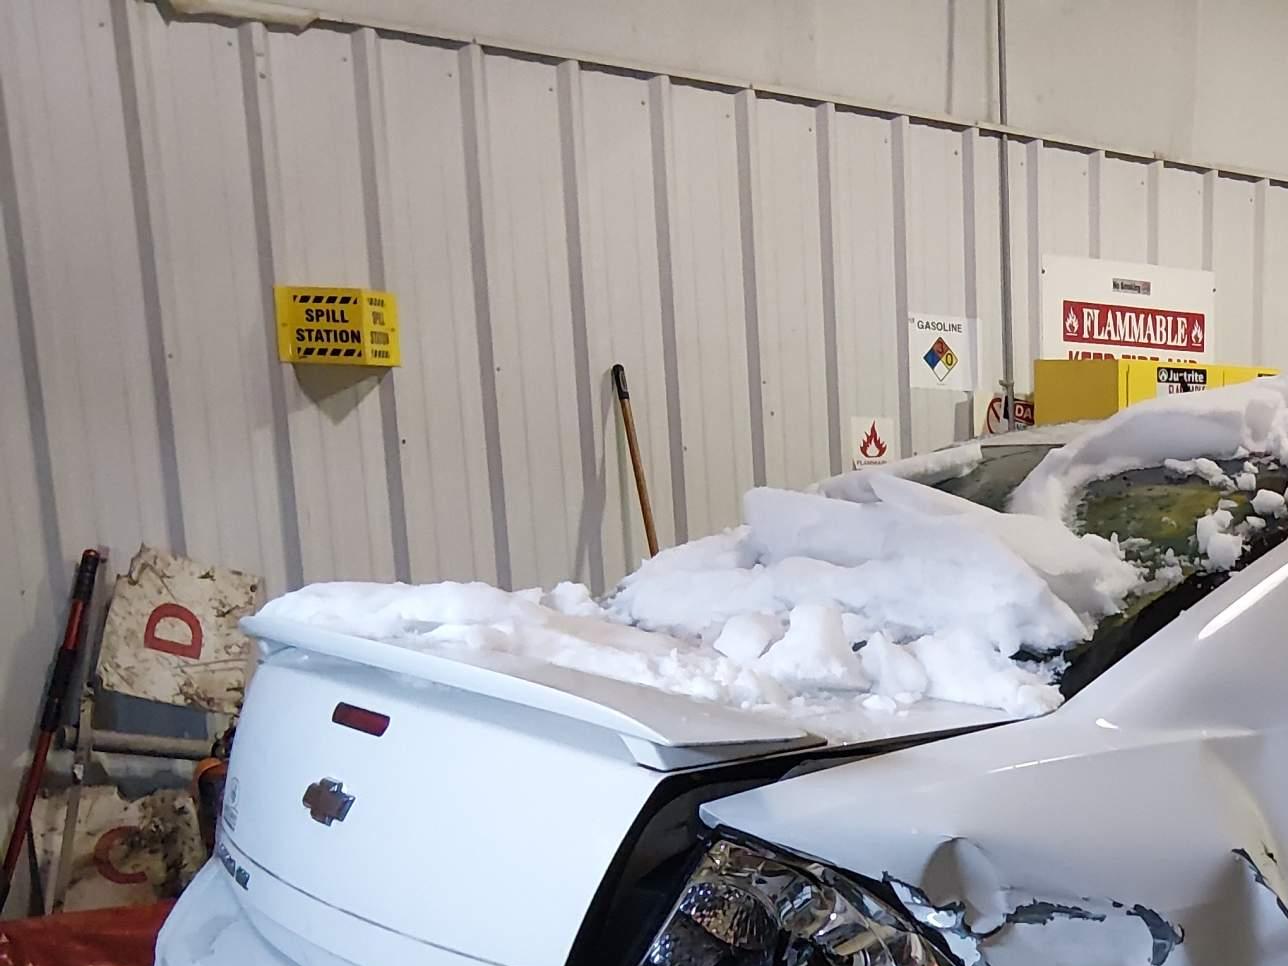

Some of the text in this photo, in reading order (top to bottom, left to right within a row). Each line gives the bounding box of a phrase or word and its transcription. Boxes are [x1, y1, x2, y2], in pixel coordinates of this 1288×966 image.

[305, 308, 349, 323] SPILL
[917, 320, 963, 333] GASOLINE
[1082, 308, 1188, 347] FLAMMABLE
[296, 328, 362, 344] STATION
